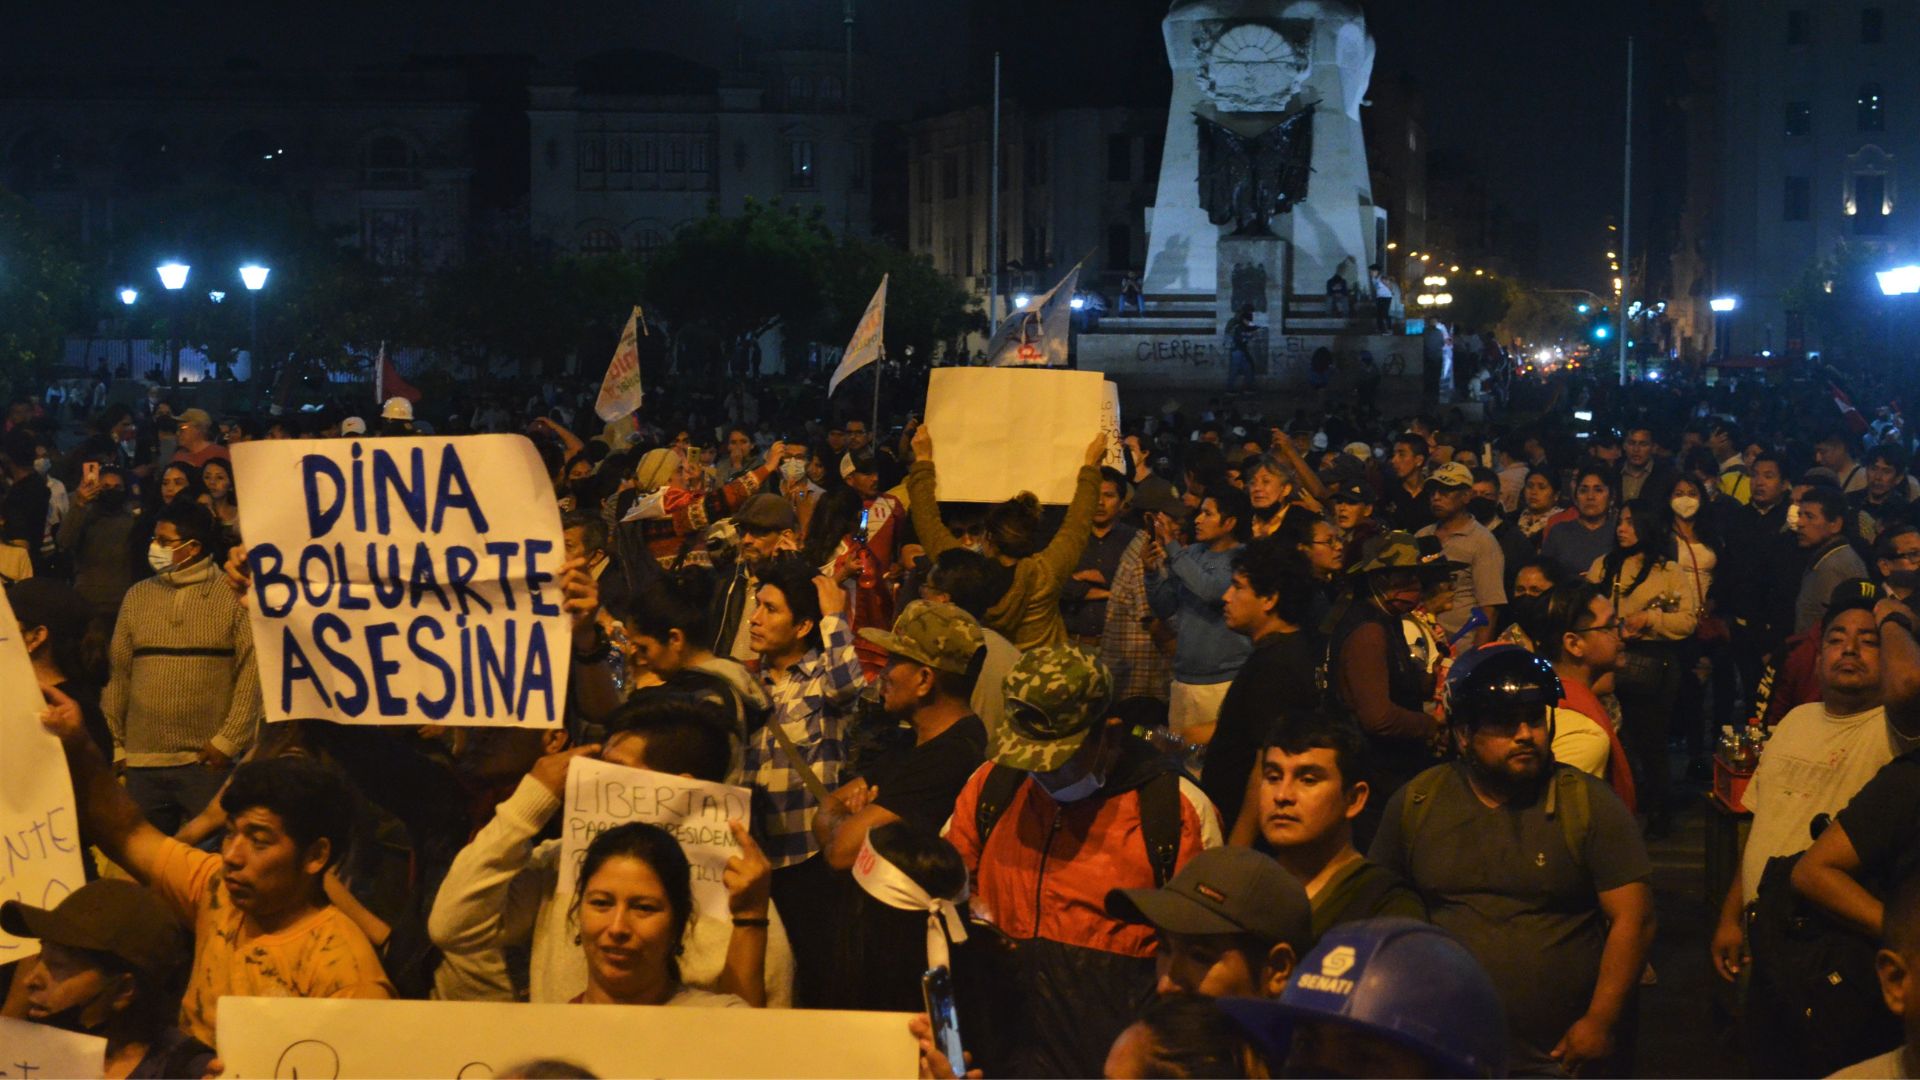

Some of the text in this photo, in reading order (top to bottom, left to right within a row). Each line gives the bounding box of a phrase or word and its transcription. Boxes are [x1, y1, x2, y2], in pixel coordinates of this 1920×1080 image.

[303, 442, 489, 538] DINA
[248, 539, 560, 618] BOLUARTE
[282, 613, 555, 722] ASESINA
[574, 770, 744, 822] LIBERTAD
[0, 806, 77, 885] NTE
[1297, 972, 1355, 995] SENATI
